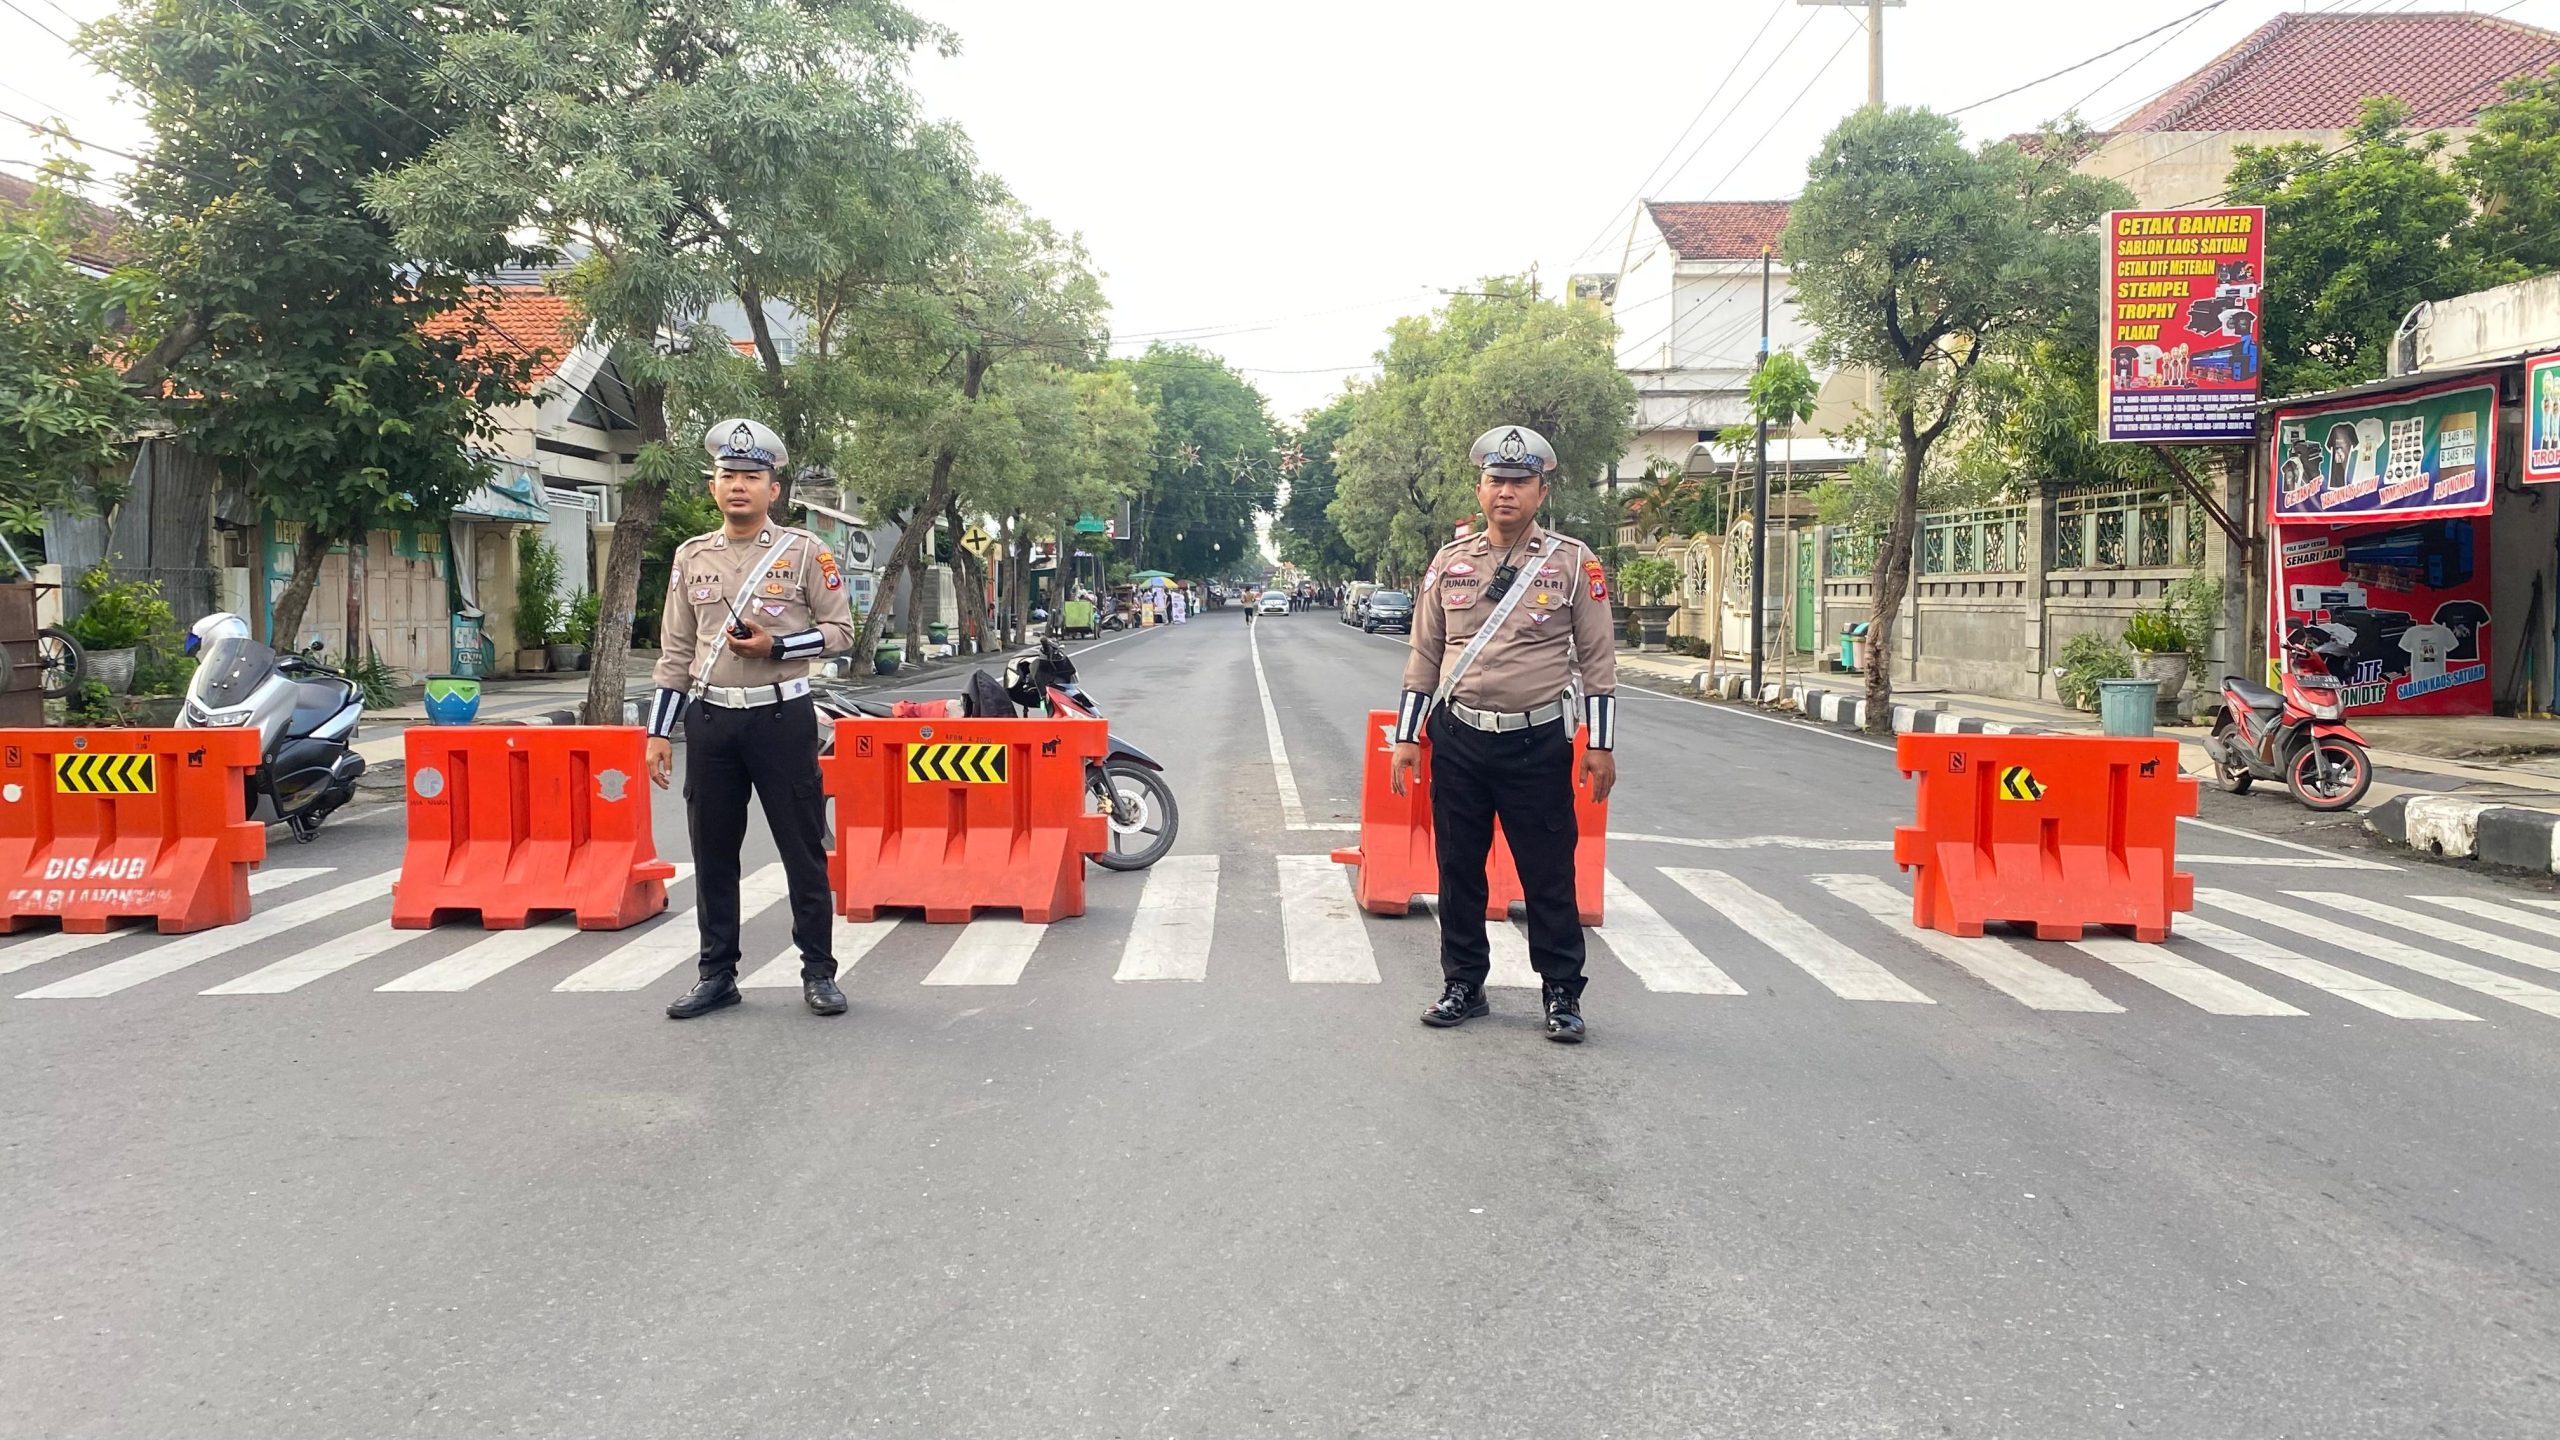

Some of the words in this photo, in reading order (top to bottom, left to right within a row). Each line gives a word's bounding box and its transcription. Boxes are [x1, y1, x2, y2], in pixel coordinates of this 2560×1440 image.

[2118, 216, 2177, 236] CETAK
[2178, 215, 2253, 235] BANNER
[2117, 239, 2165, 256] SABLON
[2165, 238, 2199, 256] KAOS
[2200, 237, 2248, 254] SATUAN
[2117, 260, 2149, 277] CETAK
[2149, 260, 2169, 276] DTF
[2169, 259, 2216, 275] METERAN
[2117, 281, 2190, 298] STEMPEL
[2117, 303, 2178, 320] TROPHY
[2117, 324, 2161, 341] PLAKAT
[2286, 552, 2320, 566] SEHARI
[2322, 548, 2343, 560] JADI
[690, 575, 720, 584] JAYA
[765, 571, 794, 579] OLRI
[1444, 579, 1479, 588] JUNAIDI
[1532, 579, 1563, 589] OLRI
[2397, 679, 2430, 700] SABLON
[2430, 673, 2453, 692] KAOS
[2453, 664, 2486, 685] SATUAN
[2360, 682, 2387, 705] DTF
